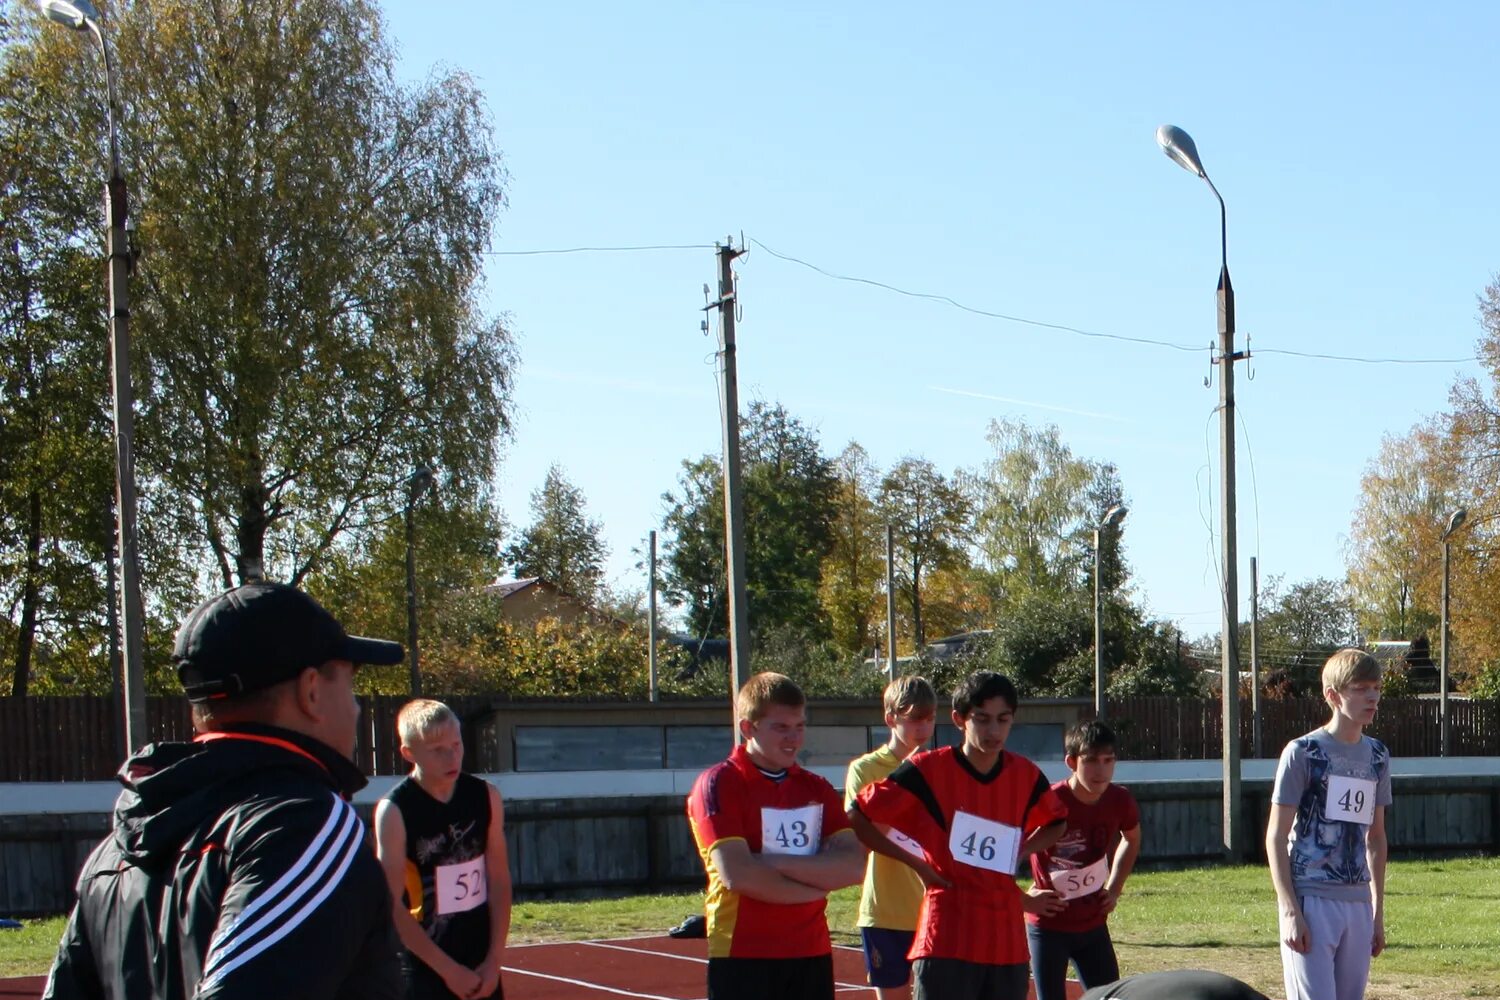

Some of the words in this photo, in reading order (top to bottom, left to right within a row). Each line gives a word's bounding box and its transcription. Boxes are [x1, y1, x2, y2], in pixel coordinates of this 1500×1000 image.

[1338, 788, 1365, 813] 49
[775, 820, 809, 848] 43
[960, 831, 996, 861] 46
[454, 869, 481, 901] 52
[1067, 871, 1095, 892] 56
